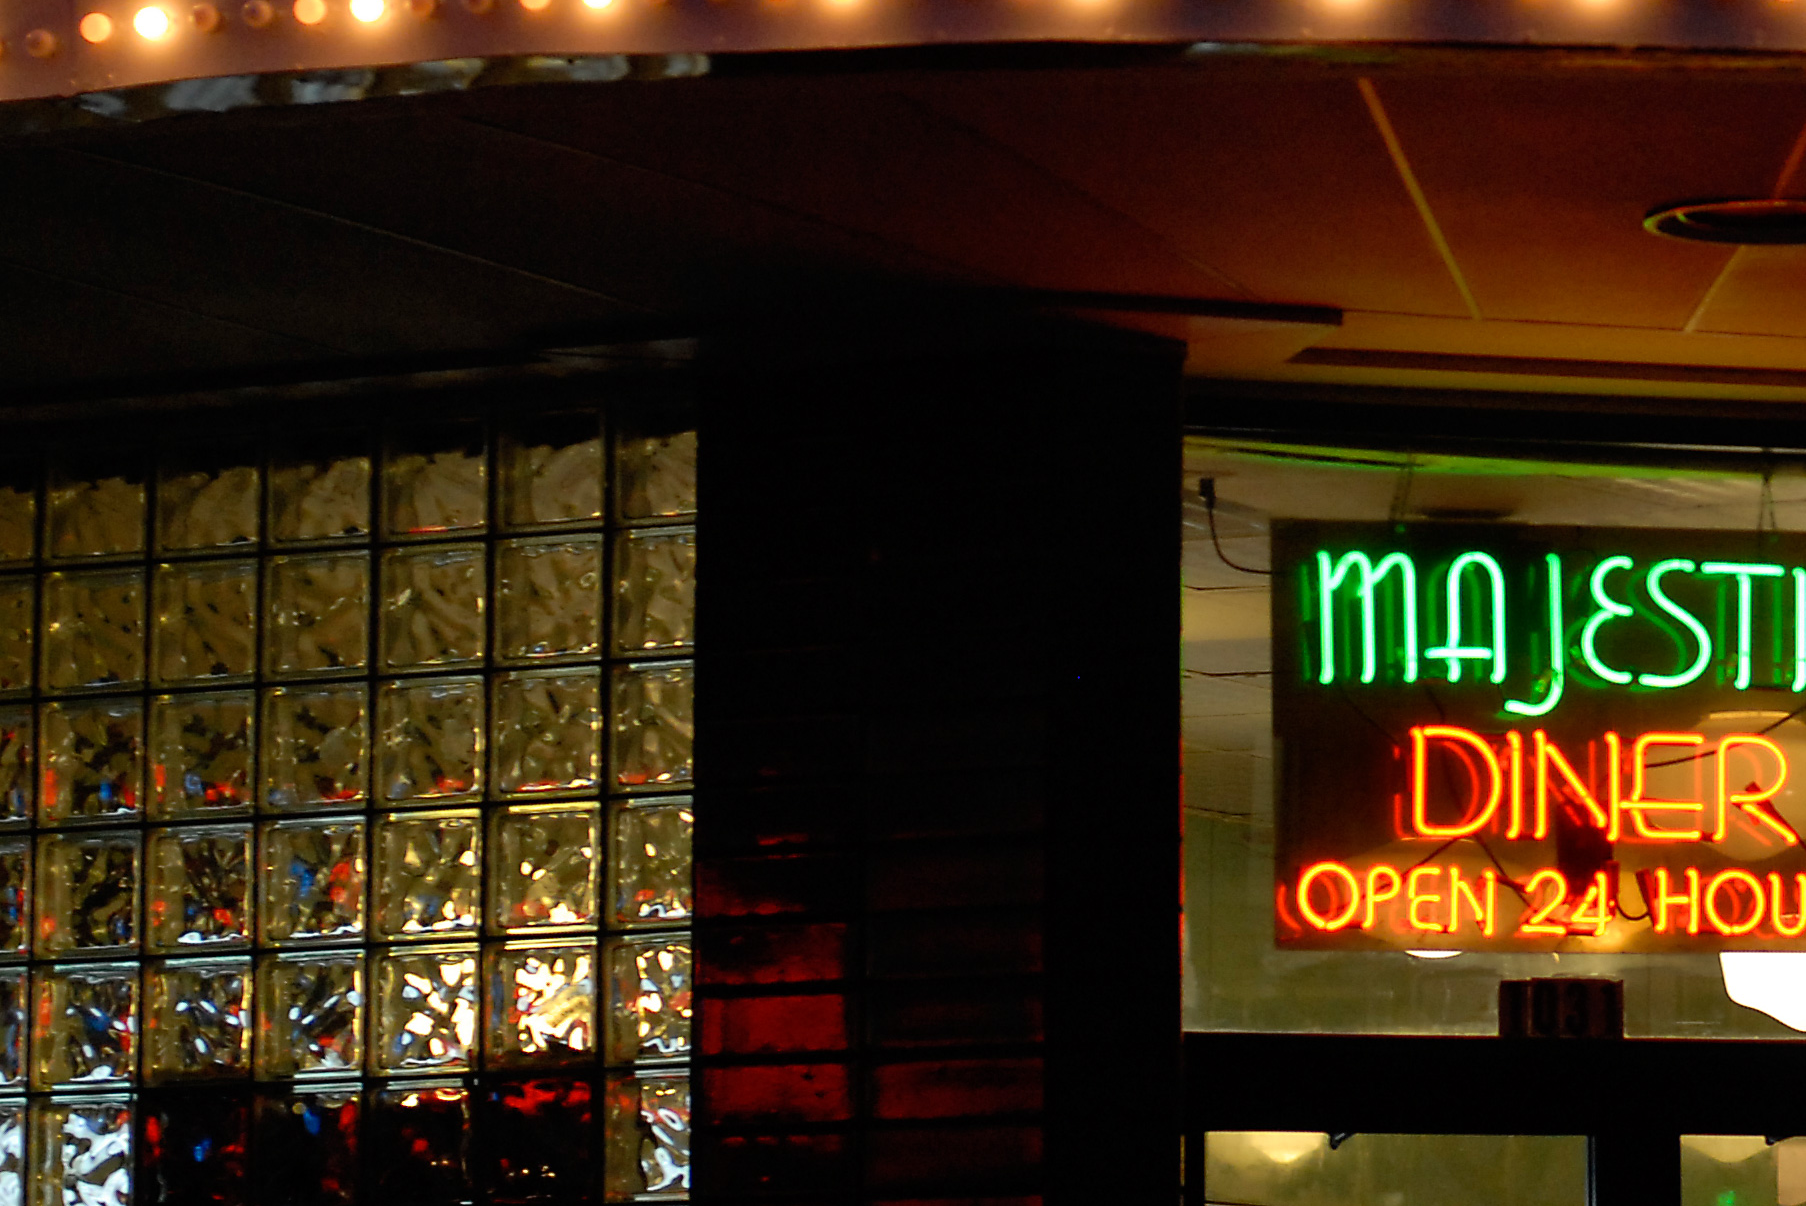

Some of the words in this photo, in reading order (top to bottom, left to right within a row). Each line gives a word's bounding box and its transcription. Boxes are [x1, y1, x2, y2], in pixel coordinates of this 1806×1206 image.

[1408, 724, 1799, 846] DINER
[1296, 860, 1495, 937] OPEN
[1520, 868, 1612, 938] 24
